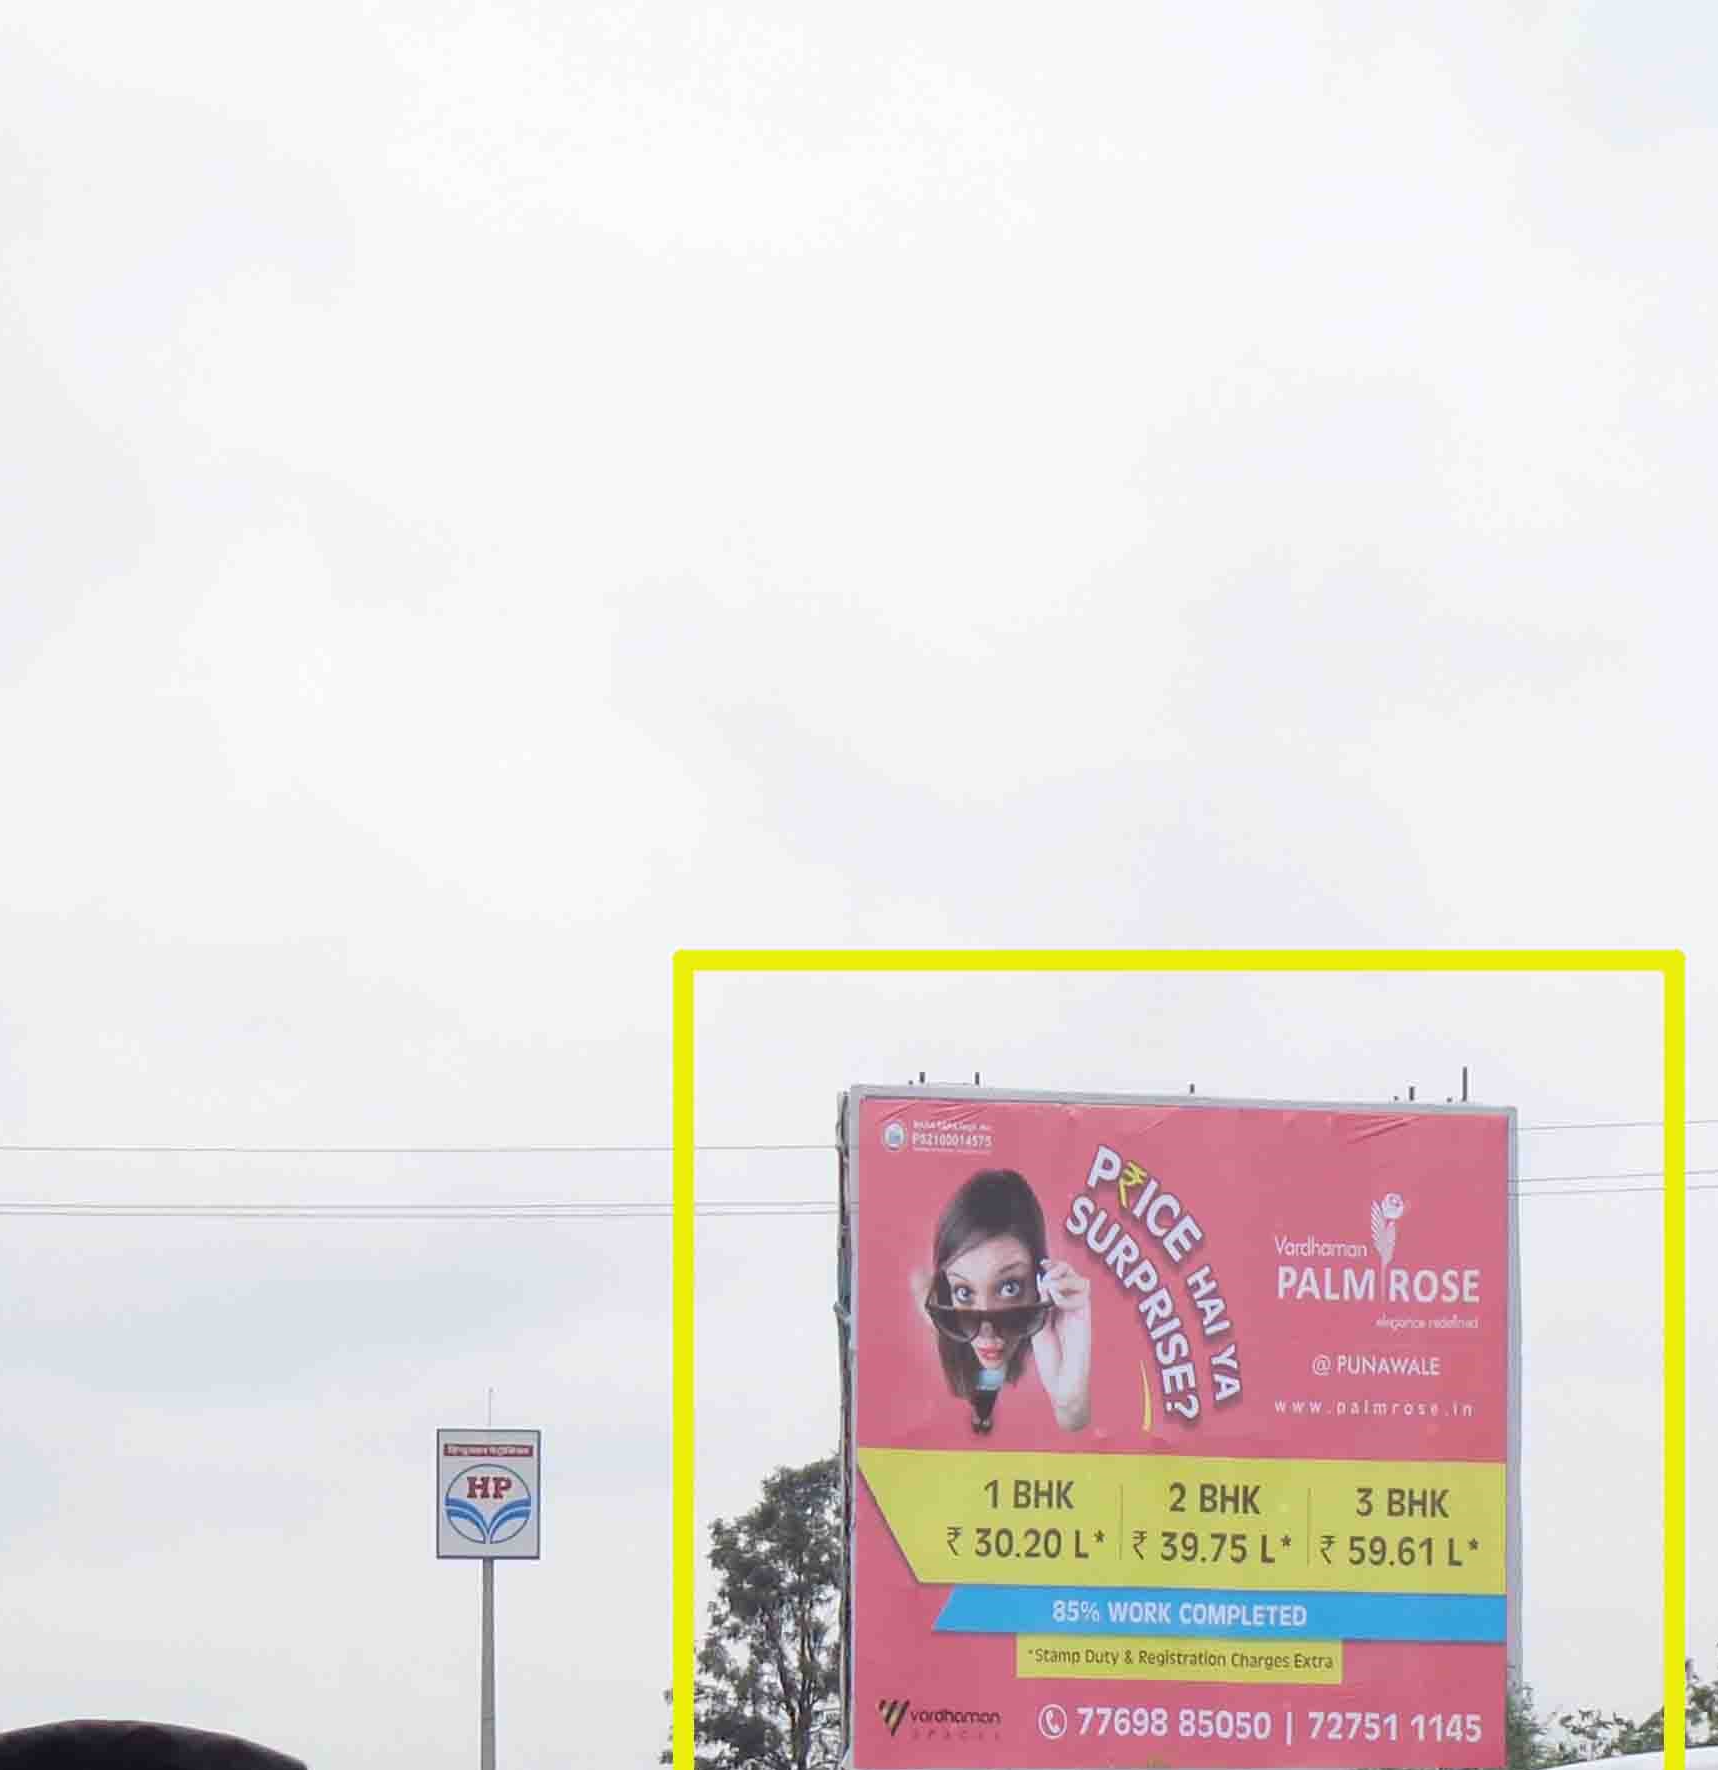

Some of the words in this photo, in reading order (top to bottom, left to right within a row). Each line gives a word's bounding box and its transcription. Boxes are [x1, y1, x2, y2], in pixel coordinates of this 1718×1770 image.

[1274, 1235, 1368, 1257] Vardhaman
[1277, 1266, 1376, 1301] PALM
[1388, 1269, 1481, 1304] ROSE
[1066, 1196, 1200, 1419] SURPRISE?
[1186, 1264, 1230, 1335] HAI
[1210, 1344, 1241, 1401] YA
[1312, 1355, 1331, 1376] @
[1337, 1355, 1441, 1376] PUNAWALE
[466, 1476, 512, 1499] HP
[984, 1479, 998, 1509] 1
[1013, 1480, 1074, 1510] BHK
[1169, 1482, 1186, 1512] 2
[1200, 1483, 1260, 1515] BHK
[1356, 1487, 1372, 1517] 3
[1387, 1488, 1450, 1518] BHK
[974, 1528, 1062, 1559] 30.20
[1160, 1531, 1247, 1562] 39.75
[1349, 1535, 1432, 1566] 59.61
[1052, 1600, 1100, 1623] 85%
[1108, 1602, 1171, 1624] WORK
[1179, 1603, 1307, 1626] COMPLETED
[1085, 1650, 1119, 1666] Duty
[1124, 1650, 1134, 1664] &
[1138, 1650, 1227, 1668] Registration
[1231, 1653, 1291, 1670] Charges
[1294, 1653, 1333, 1669] Extra
[1077, 1706, 1169, 1738] 77698
[1179, 1709, 1271, 1740] 85050
[1308, 1711, 1399, 1741] 72751
[1411, 1714, 1483, 1743] 1145
